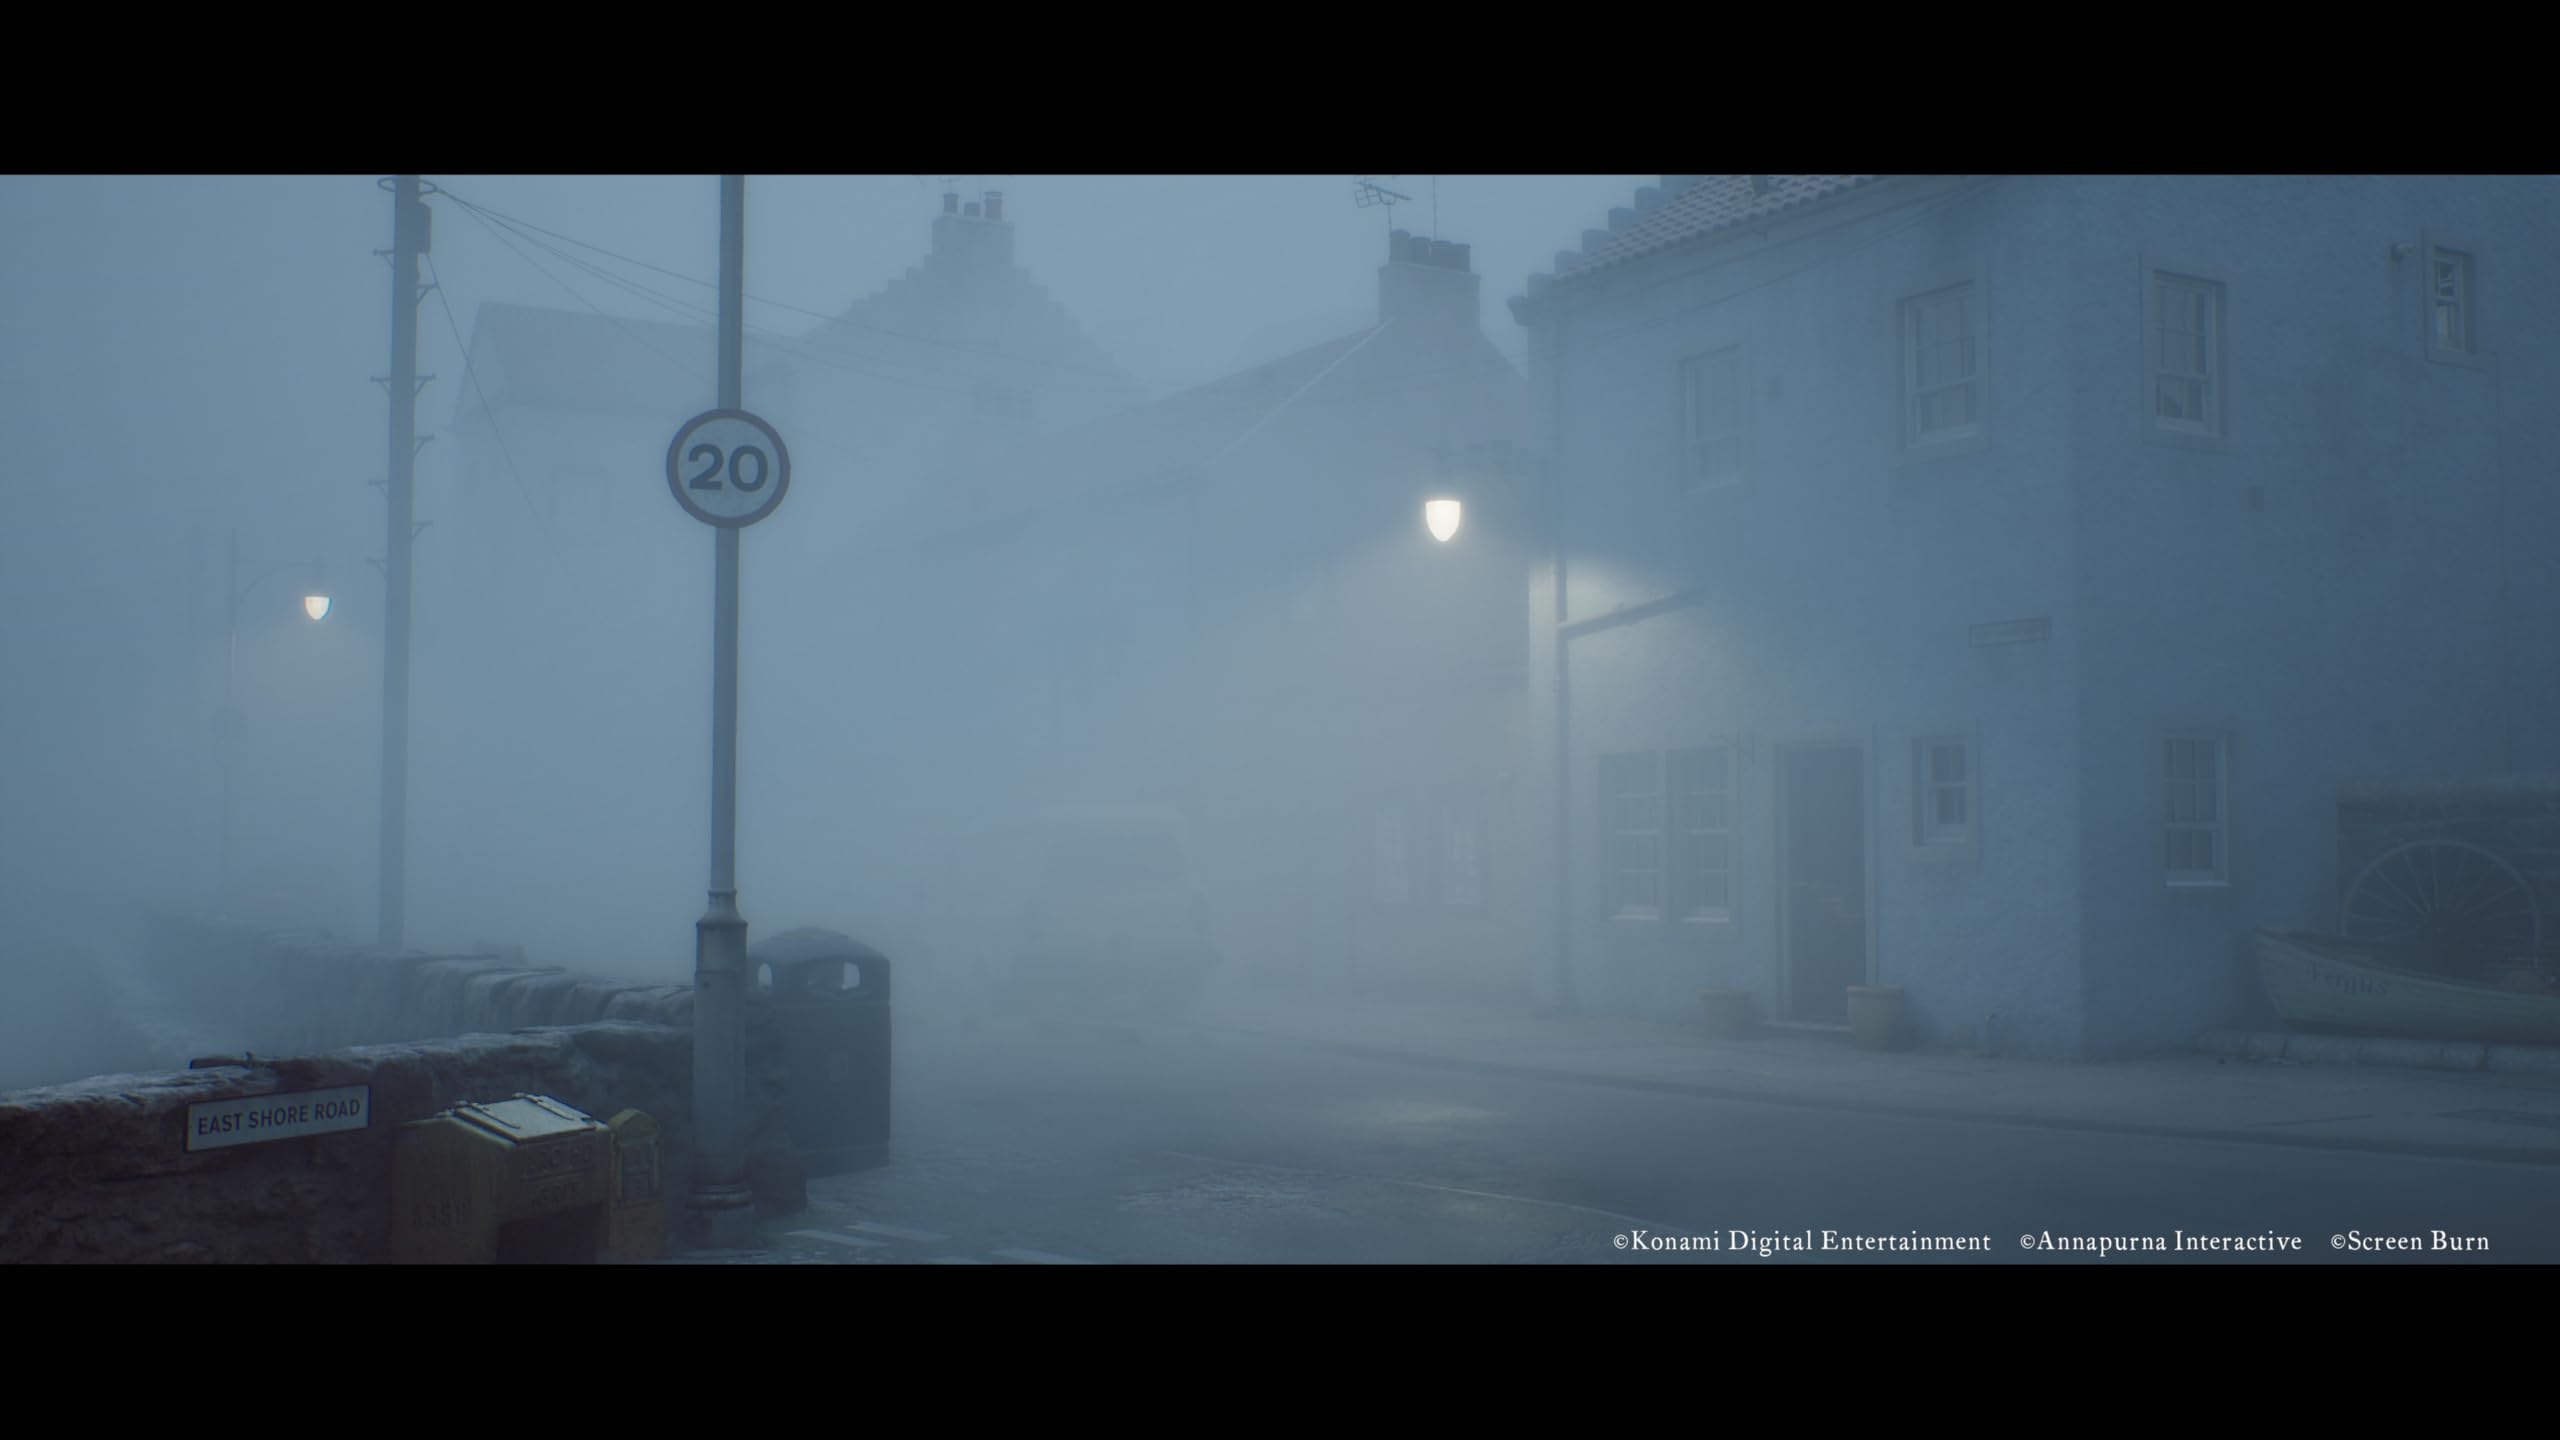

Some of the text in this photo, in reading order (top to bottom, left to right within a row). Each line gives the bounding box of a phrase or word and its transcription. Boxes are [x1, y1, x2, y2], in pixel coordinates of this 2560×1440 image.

[688, 443, 769, 492] 20
[198, 1098, 361, 1136] EAST SHORE ROAD
